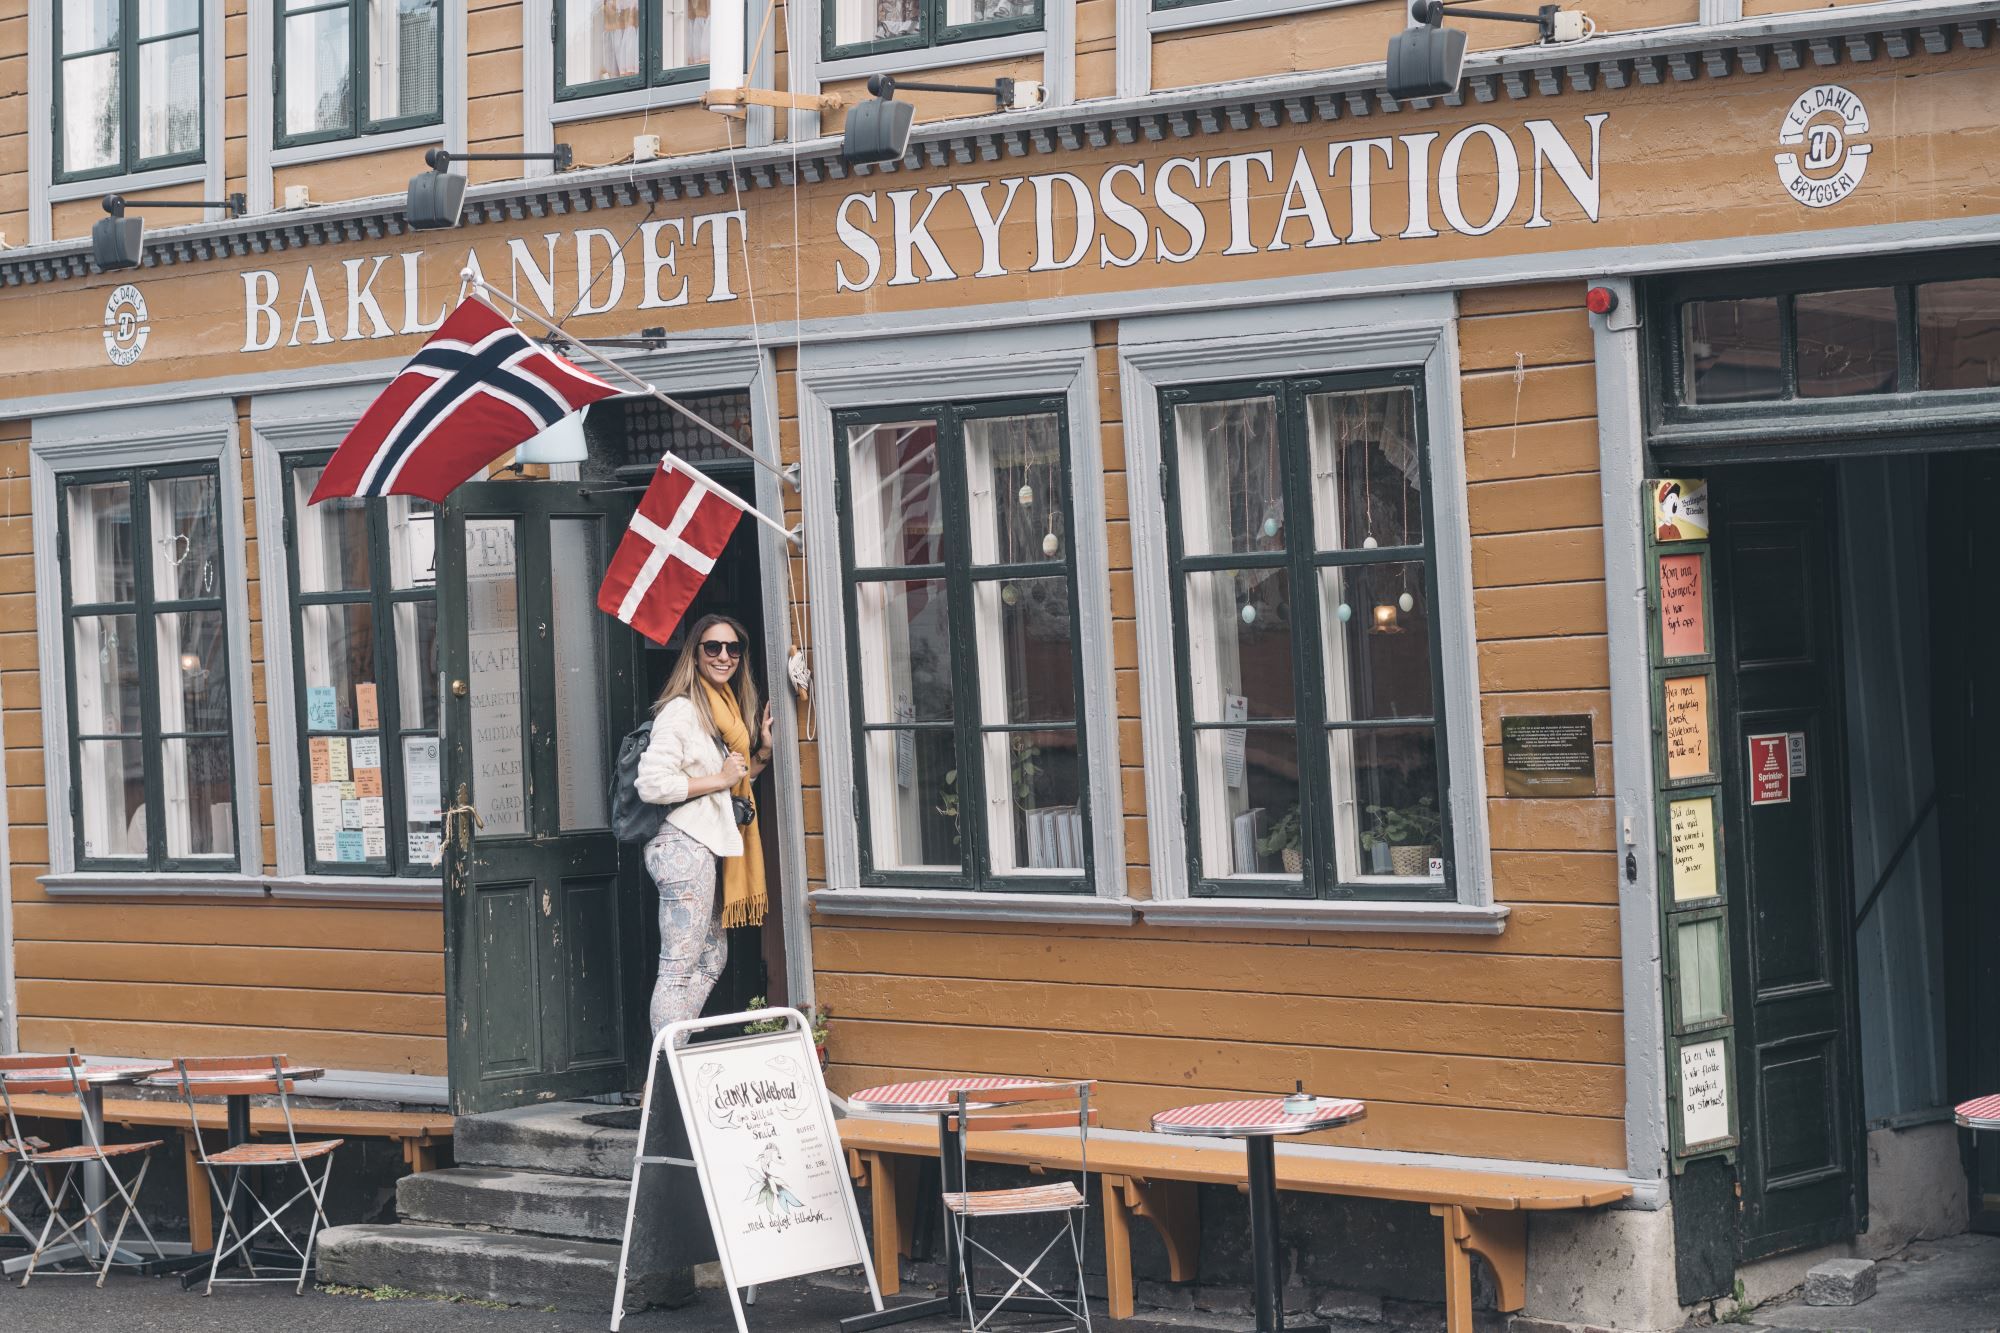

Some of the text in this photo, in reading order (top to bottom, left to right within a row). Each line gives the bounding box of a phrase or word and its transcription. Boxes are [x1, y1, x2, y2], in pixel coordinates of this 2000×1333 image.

[1815, 87, 1861, 121] DAHLS
[835, 112, 1610, 294] SKYDSSTATION
[1790, 172, 1855, 203] BRYGGERI
[109, 342, 142, 365] BRYGGERI
